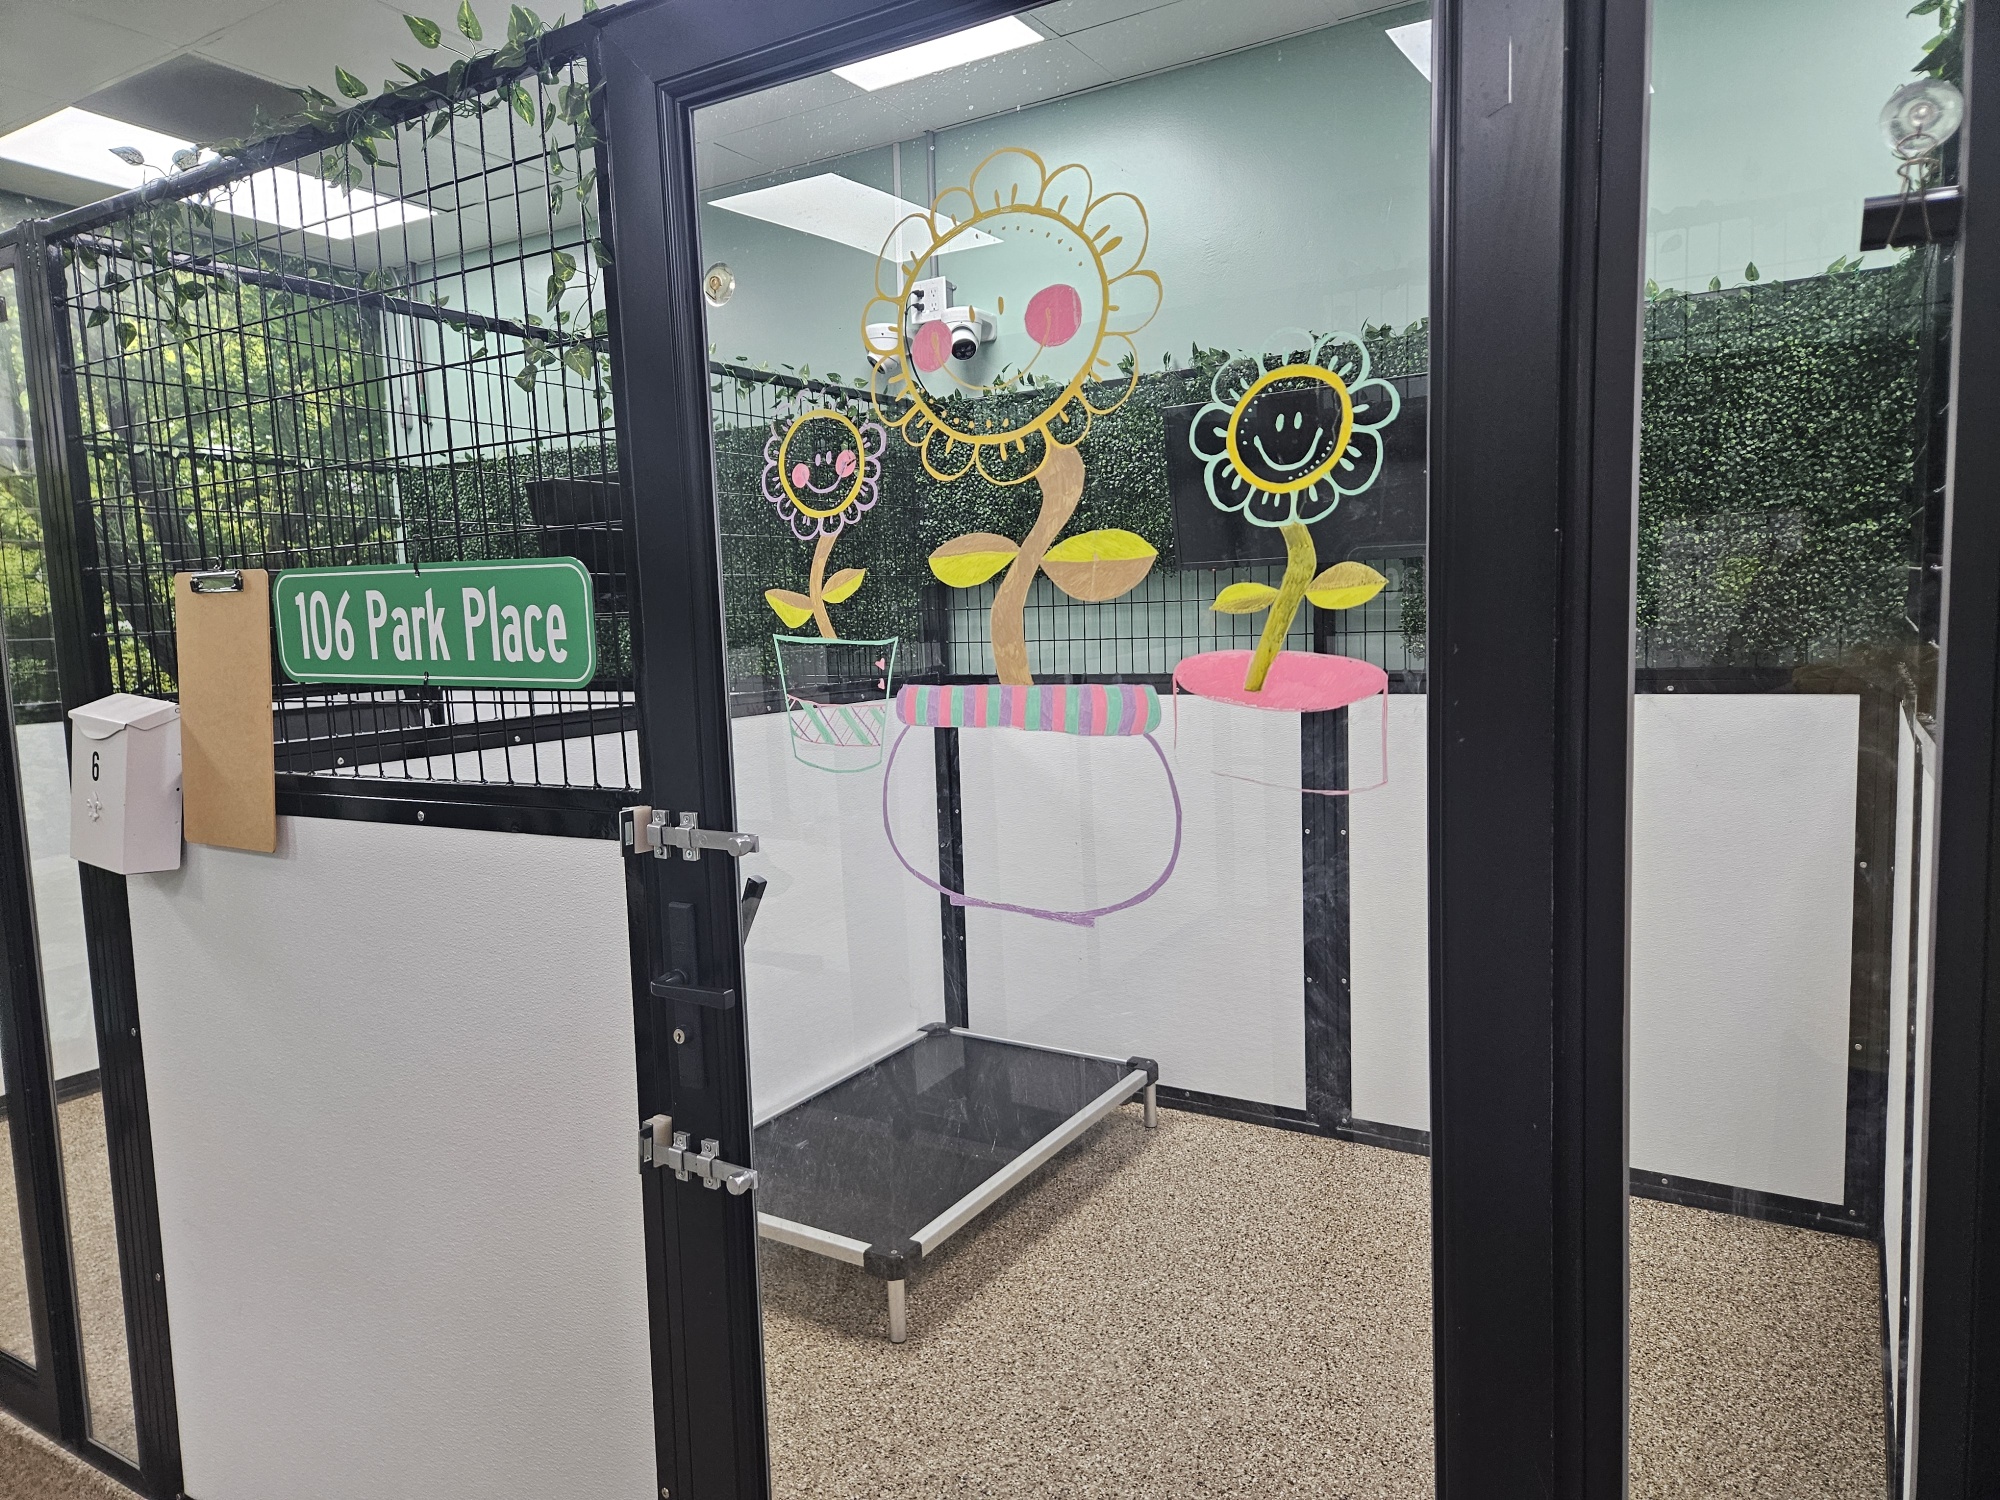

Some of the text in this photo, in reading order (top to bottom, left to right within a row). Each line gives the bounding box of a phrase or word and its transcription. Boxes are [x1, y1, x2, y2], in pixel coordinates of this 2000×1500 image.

[295, 586, 568, 663] 106 Park Place
[92, 751, 100, 781] 6
